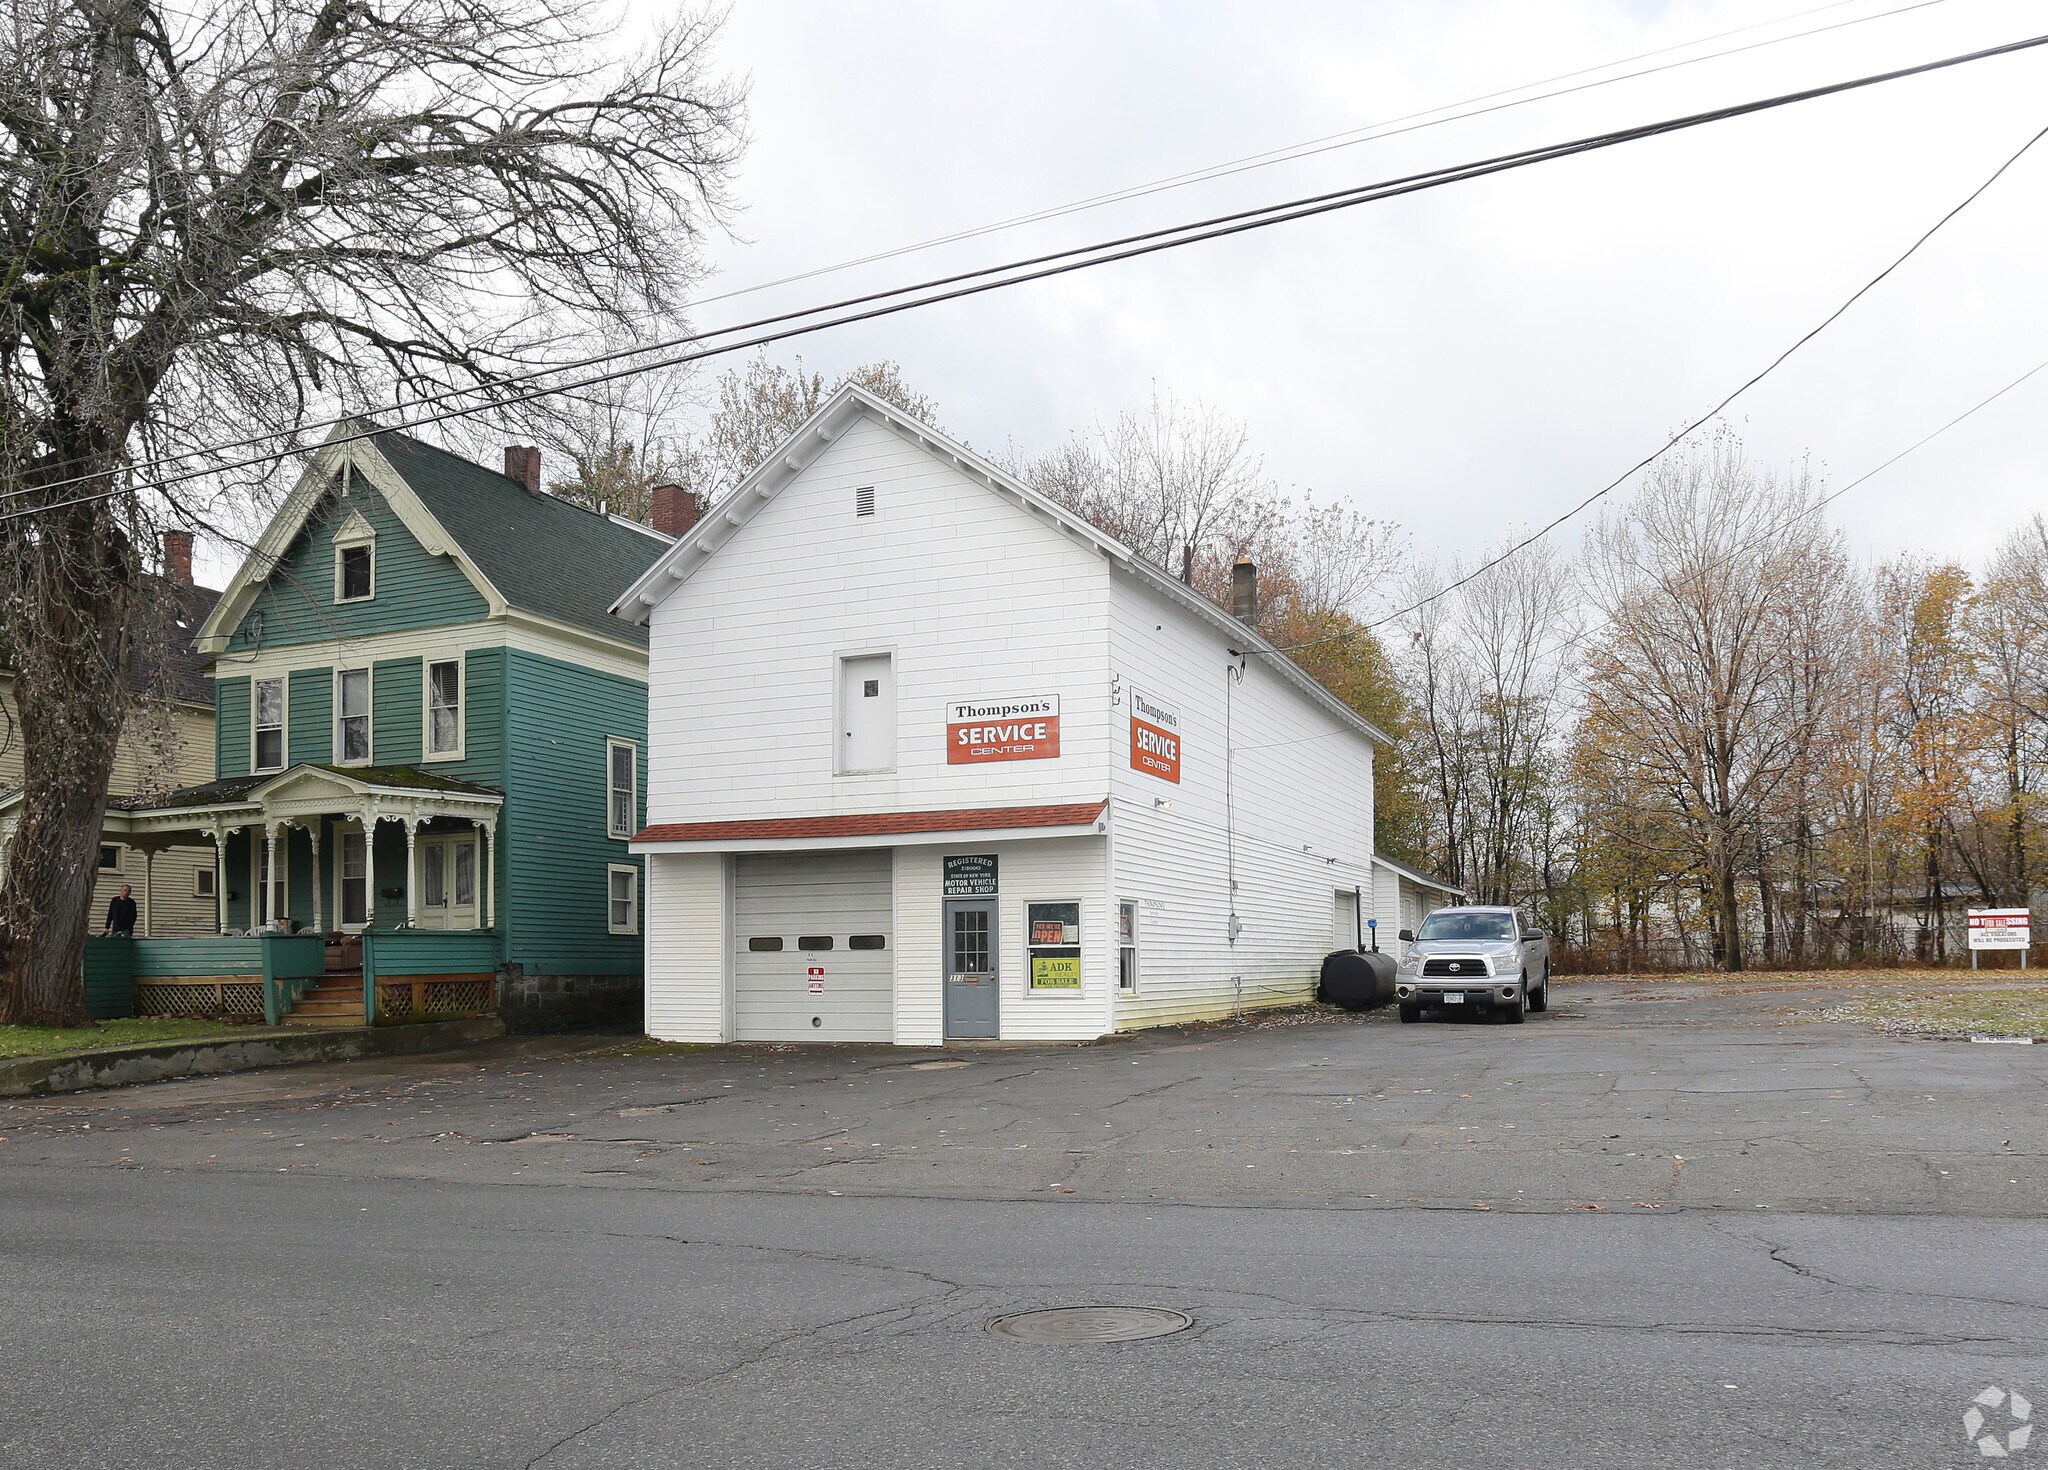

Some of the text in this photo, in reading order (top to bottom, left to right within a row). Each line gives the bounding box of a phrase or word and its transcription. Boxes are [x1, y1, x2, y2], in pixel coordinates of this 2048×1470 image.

[955, 699, 1050, 717] Thompson's
[1135, 695, 1177, 727] Thompson's
[958, 723, 1047, 745] SERVICE
[970, 744, 1034, 756] CENTER
[1137, 727, 1177, 761] SERVICE
[1142, 756, 1171, 773] CENTER
[947, 857, 993, 868] REGISTERED
[945, 878, 996, 887] MOTOR VEHICLE
[948, 886, 973, 894] REPAIR
[1969, 918, 1980, 926] NO
[1034, 930, 1061, 943] OPEN
[1050, 962, 1072, 972] ADK
